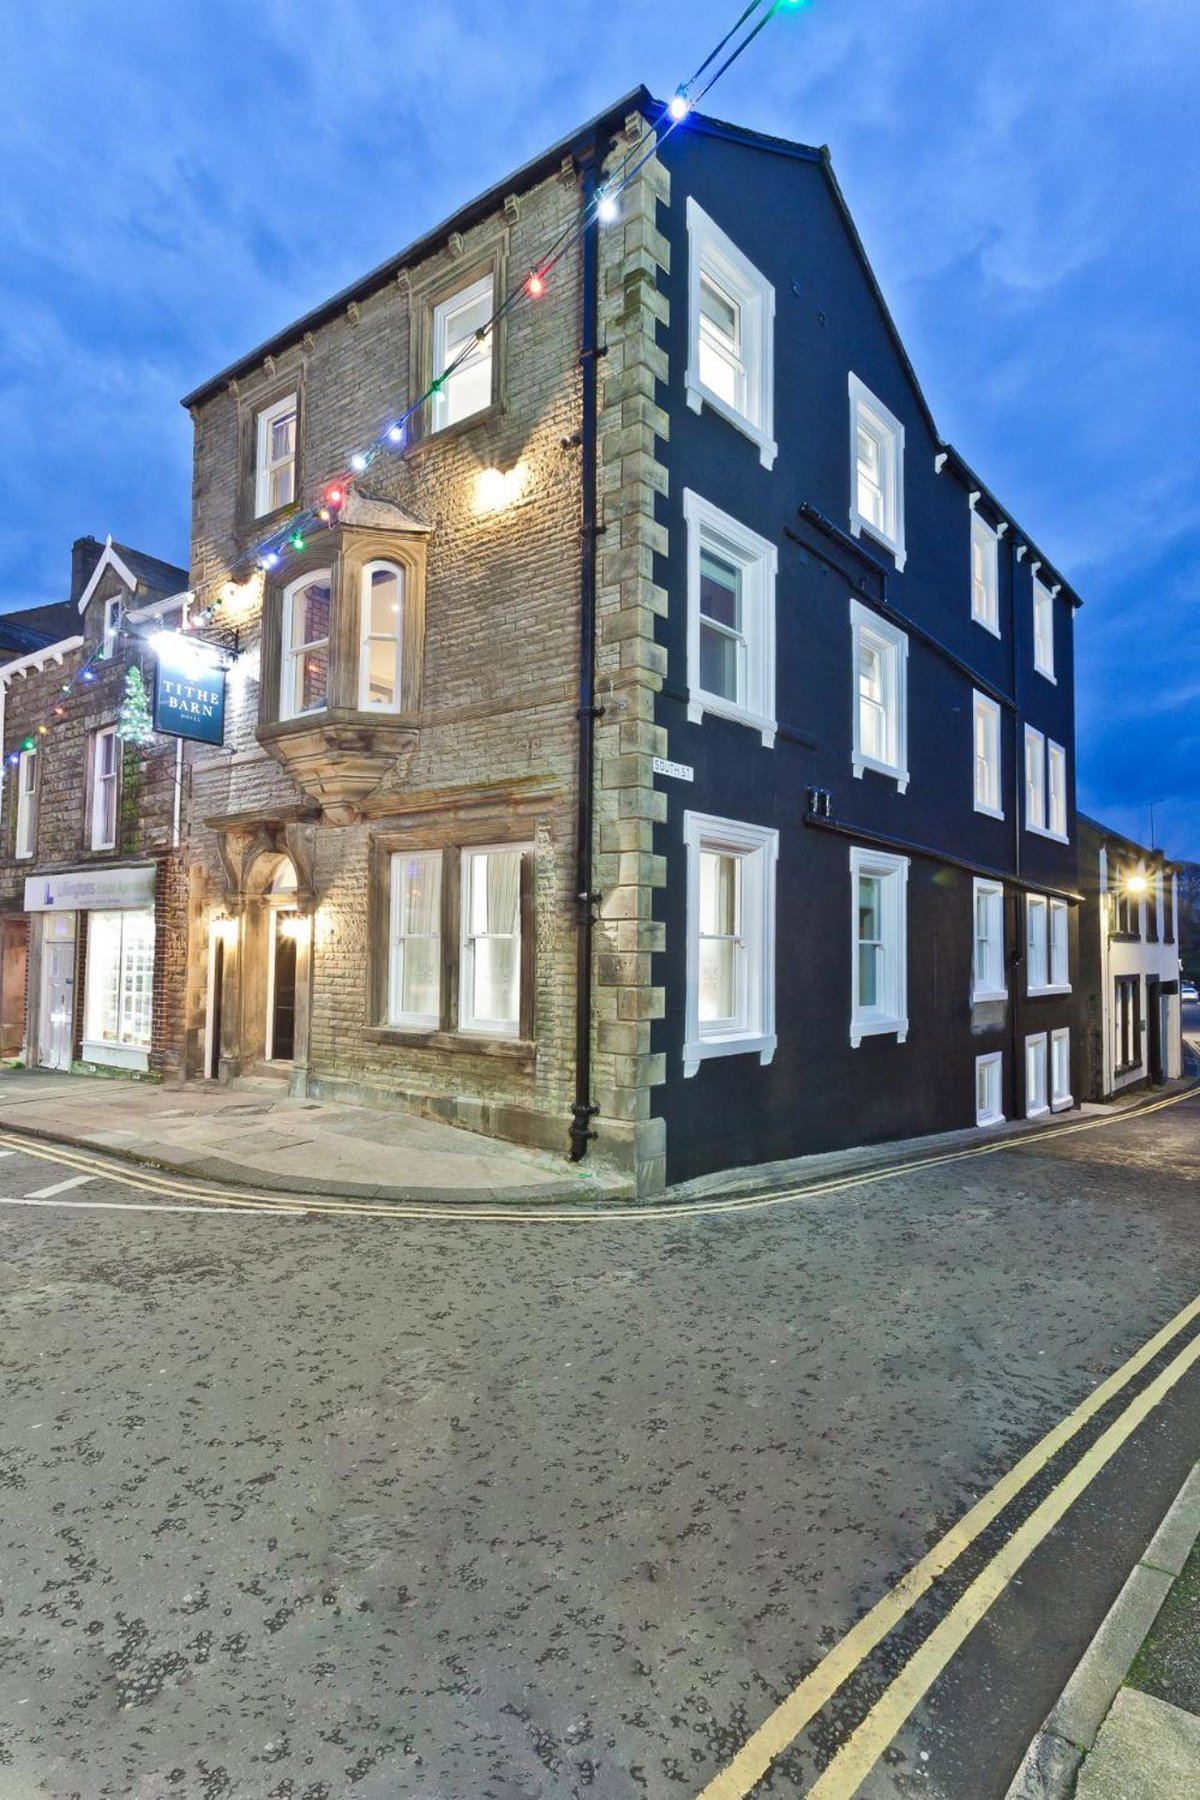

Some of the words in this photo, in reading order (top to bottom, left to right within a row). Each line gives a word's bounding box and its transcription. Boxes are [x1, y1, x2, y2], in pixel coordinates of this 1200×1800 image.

[163, 681, 219, 705] TITHE
[169, 696, 213, 717] BARN
[655, 759, 680, 776] SOUTH
